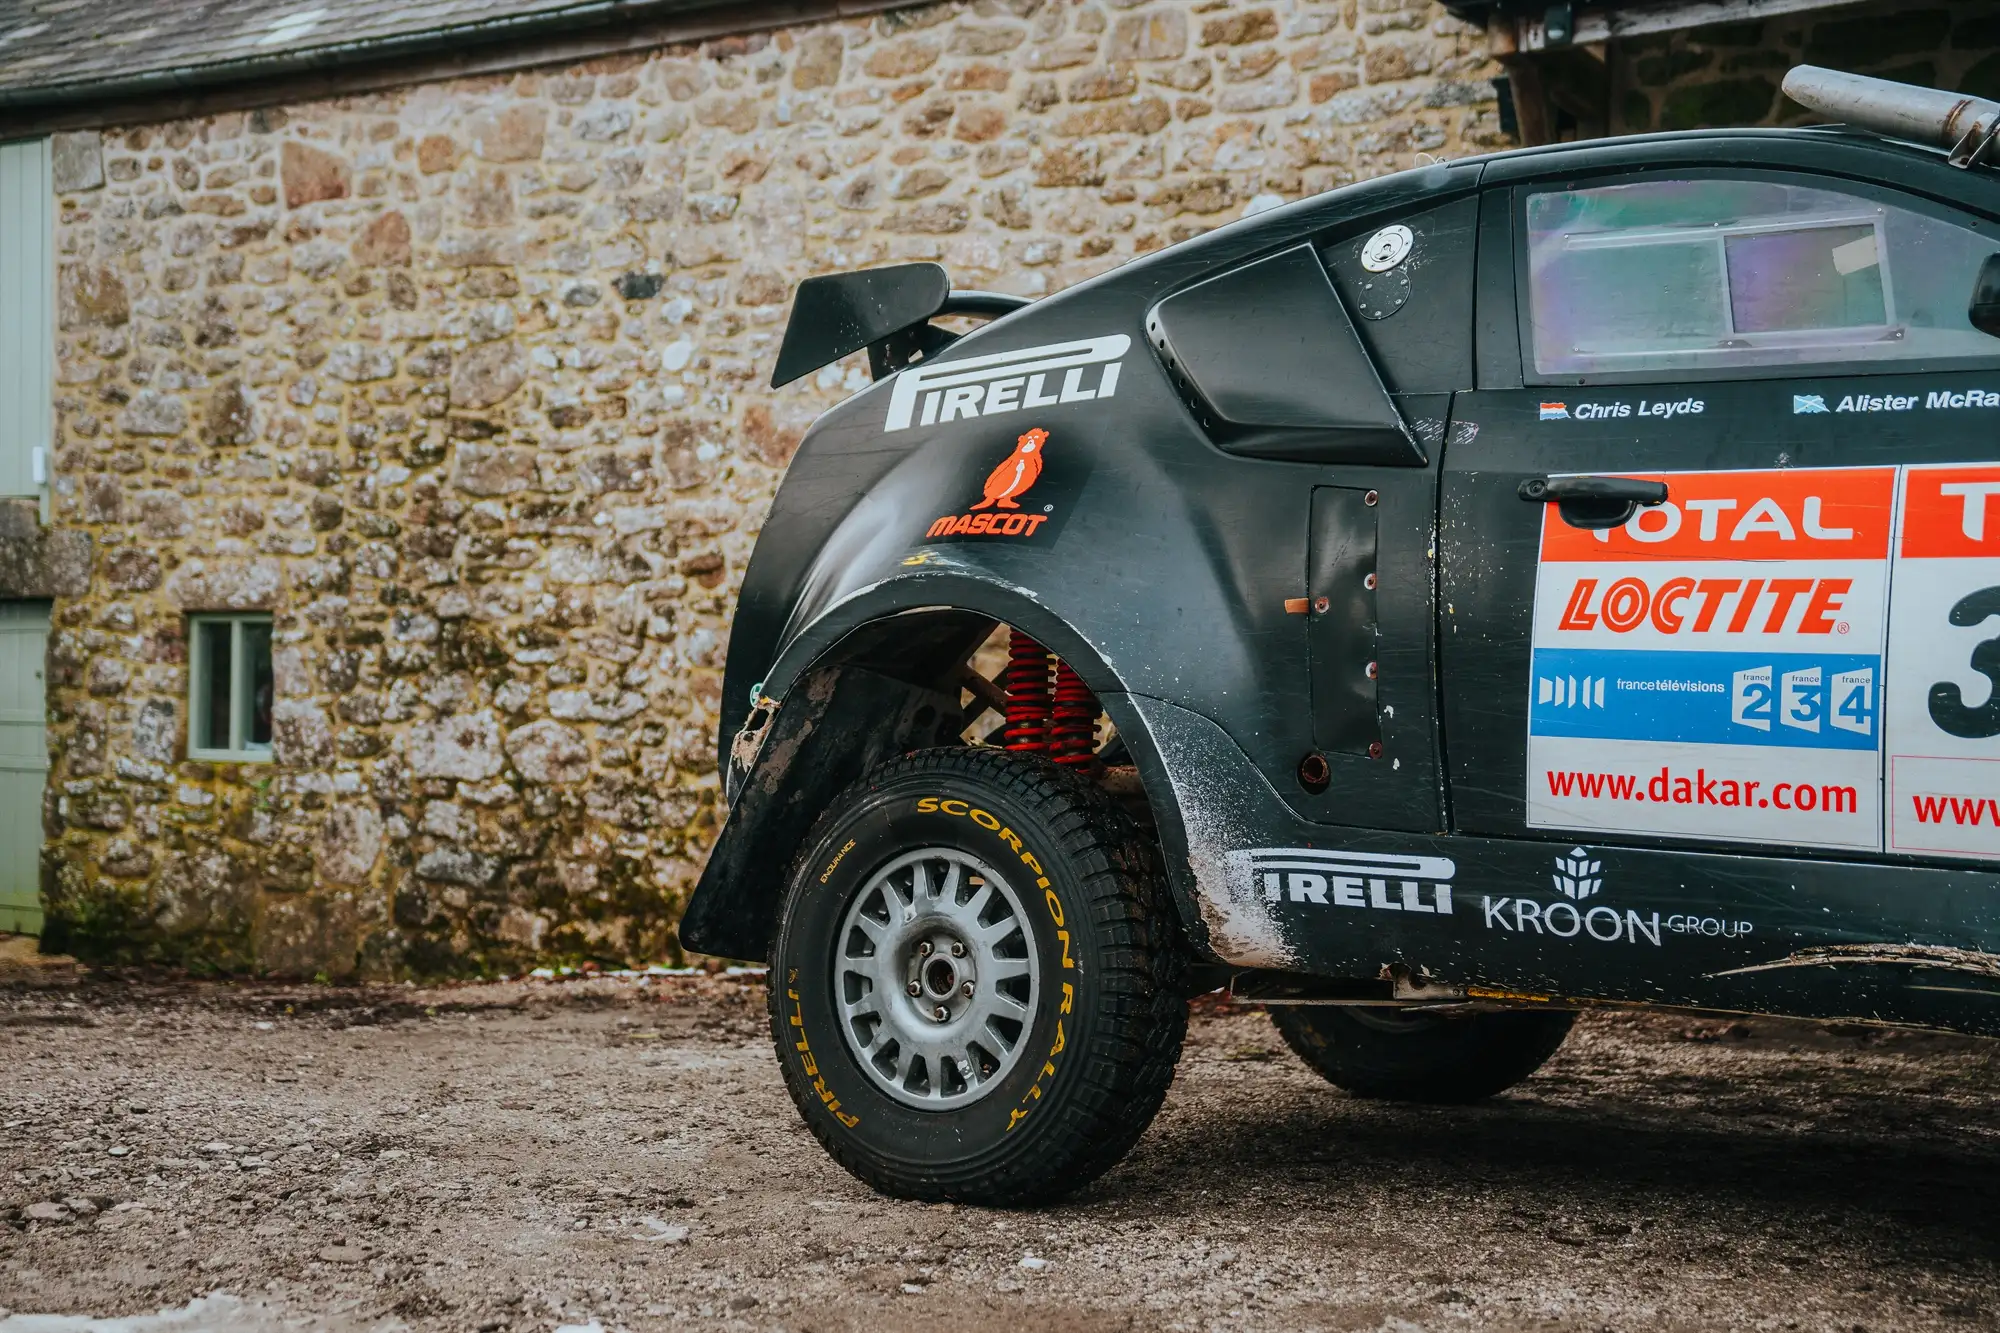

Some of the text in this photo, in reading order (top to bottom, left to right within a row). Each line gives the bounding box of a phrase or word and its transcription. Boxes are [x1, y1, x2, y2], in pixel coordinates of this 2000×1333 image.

[884, 334, 1131, 432] PIRELLI
[1574, 398, 1704, 419] Chris Leyds
[1836, 395, 1919, 412] Alister
[925, 513, 1048, 537] MASCOT
[1558, 577, 1853, 635] LOCTITE
[1743, 674, 1770, 682] france
[1792, 675, 1820, 683] france
[1842, 676, 1871, 684] france
[1741, 683, 1771, 720] 2
[1790, 684, 1820, 721] 3
[1838, 686, 1871, 724] 4
[1547, 767, 1857, 813] www.dakar.com
[820, 839, 856, 883] ENDURANCE
[1484, 896, 1753, 947] KROON GROUP
[917, 797, 1074, 1132] SCORPION RALLY
[788, 988, 860, 1128] PIRELLI
